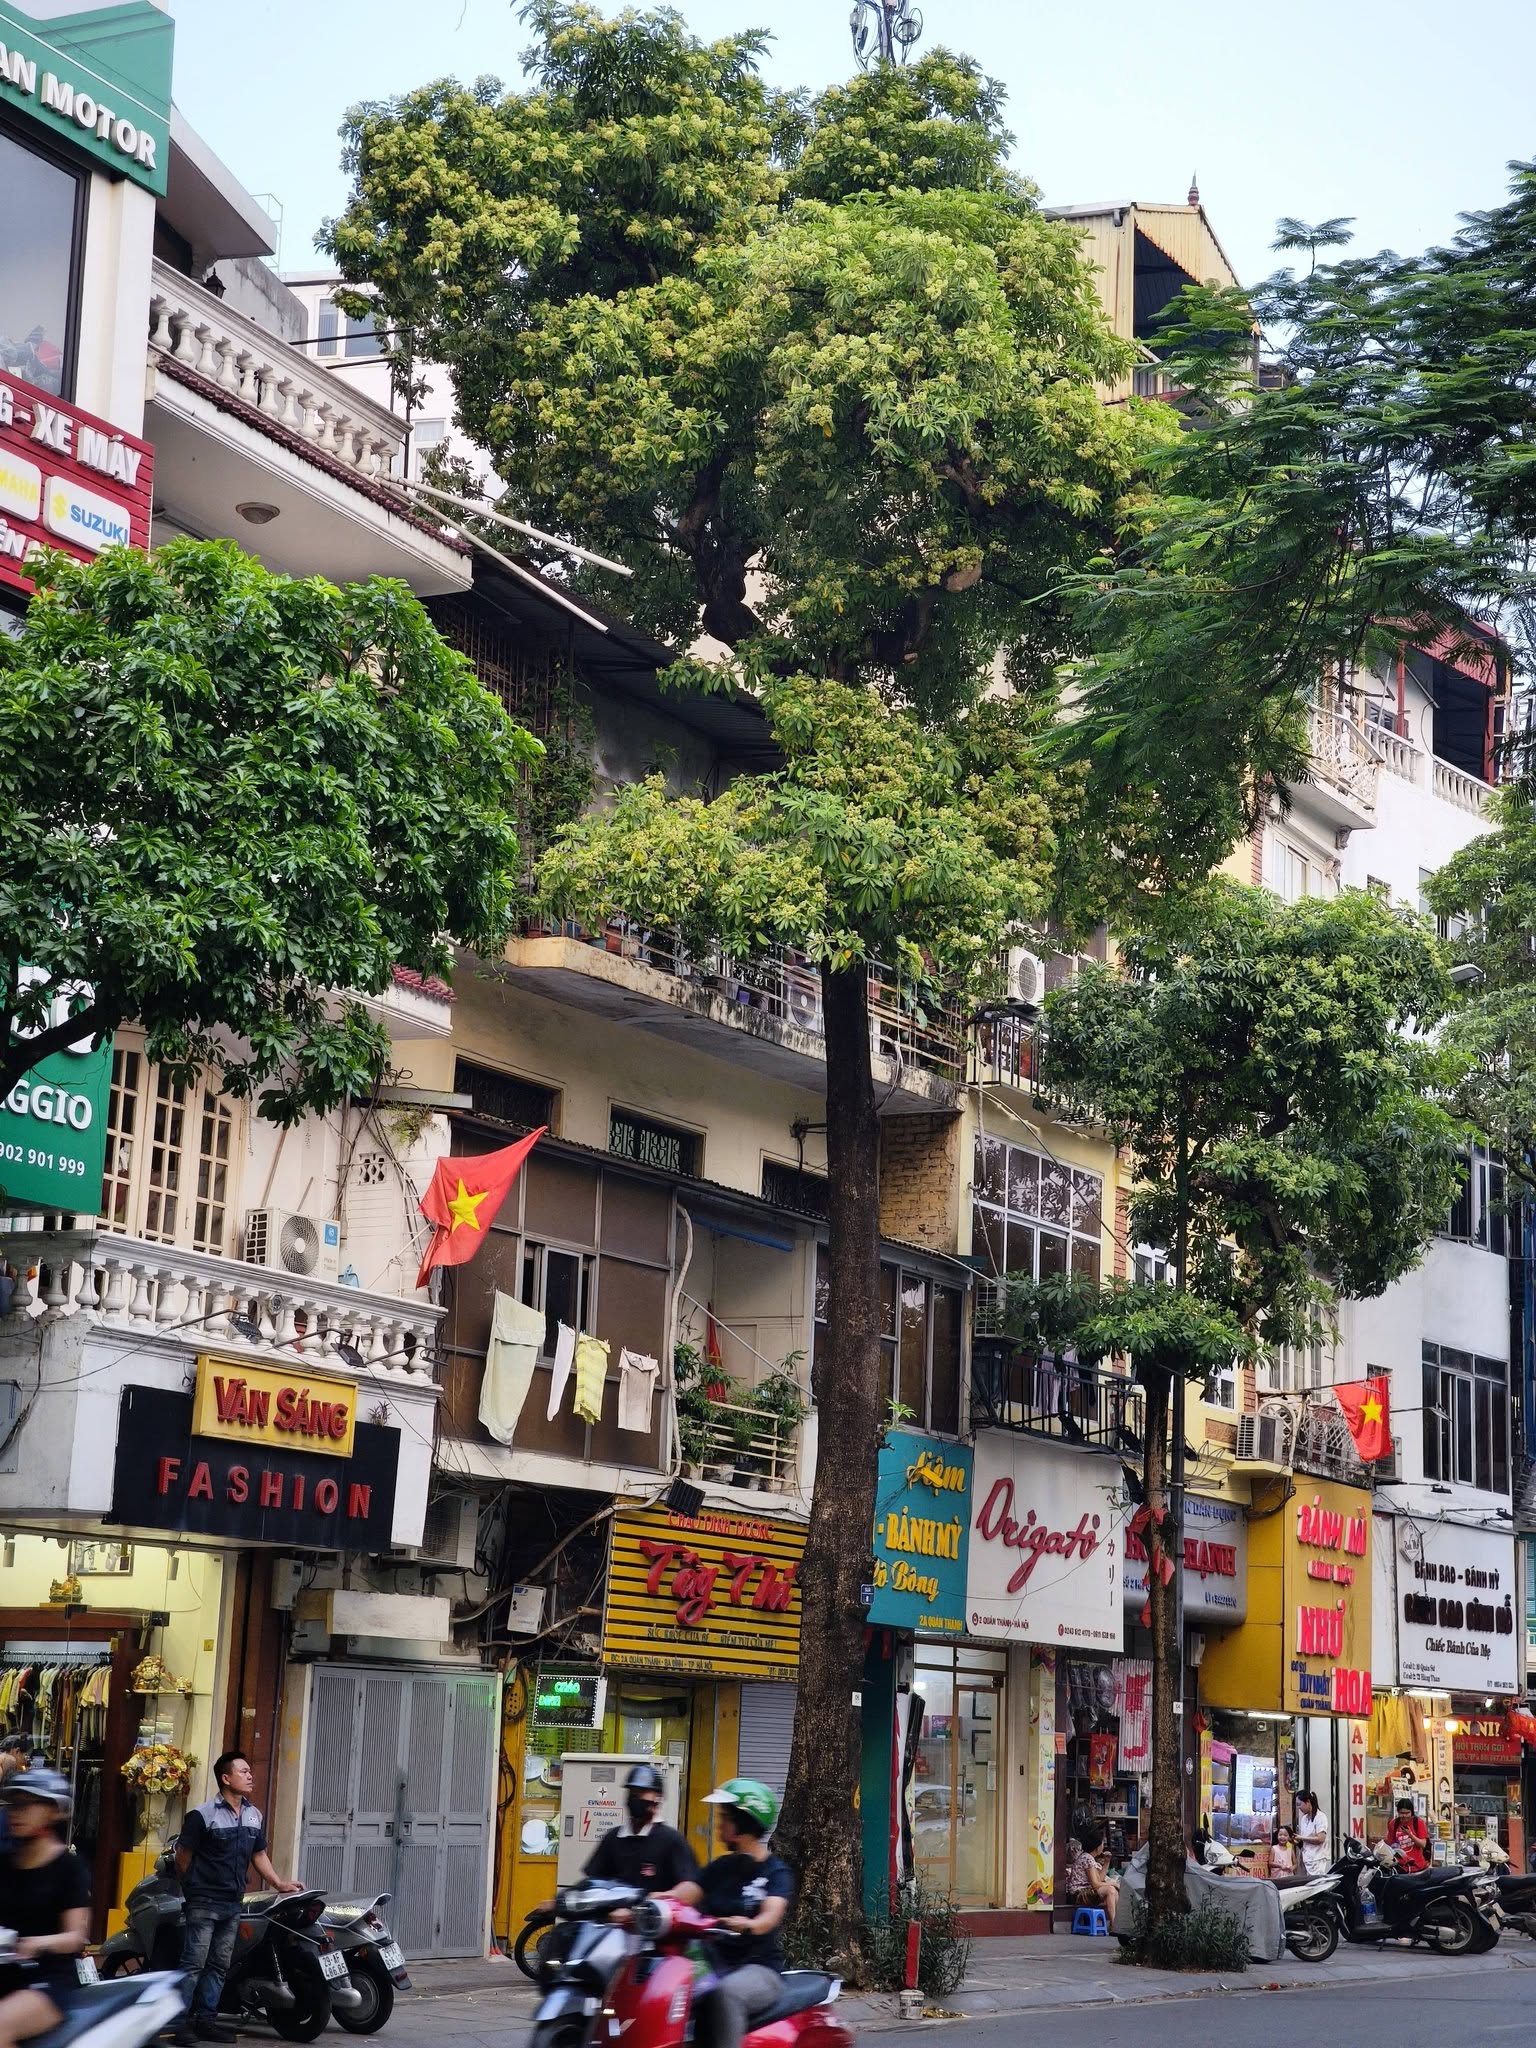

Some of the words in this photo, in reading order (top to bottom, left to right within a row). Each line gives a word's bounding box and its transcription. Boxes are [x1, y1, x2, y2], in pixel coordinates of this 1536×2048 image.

[41, 72, 157, 171] MOTOR
[77, 425, 141, 487] MÁY
[70, 504, 128, 546] SUZUKI
[27, 1148, 54, 1169] 901
[58, 1156, 85, 1177] 999
[273, 1388, 349, 1438] SÁNG
[157, 1456, 372, 1519] FASHION
[1297, 1495, 1344, 1551] BÁNH
[891, 1560, 940, 1603] Bông
[1439, 1564, 1456, 1584] BAO
[1465, 1565, 1488, 1589] BÁNH
[1446, 1639, 1465, 1655] Bánh
[1331, 1667, 1373, 1716] HOA
